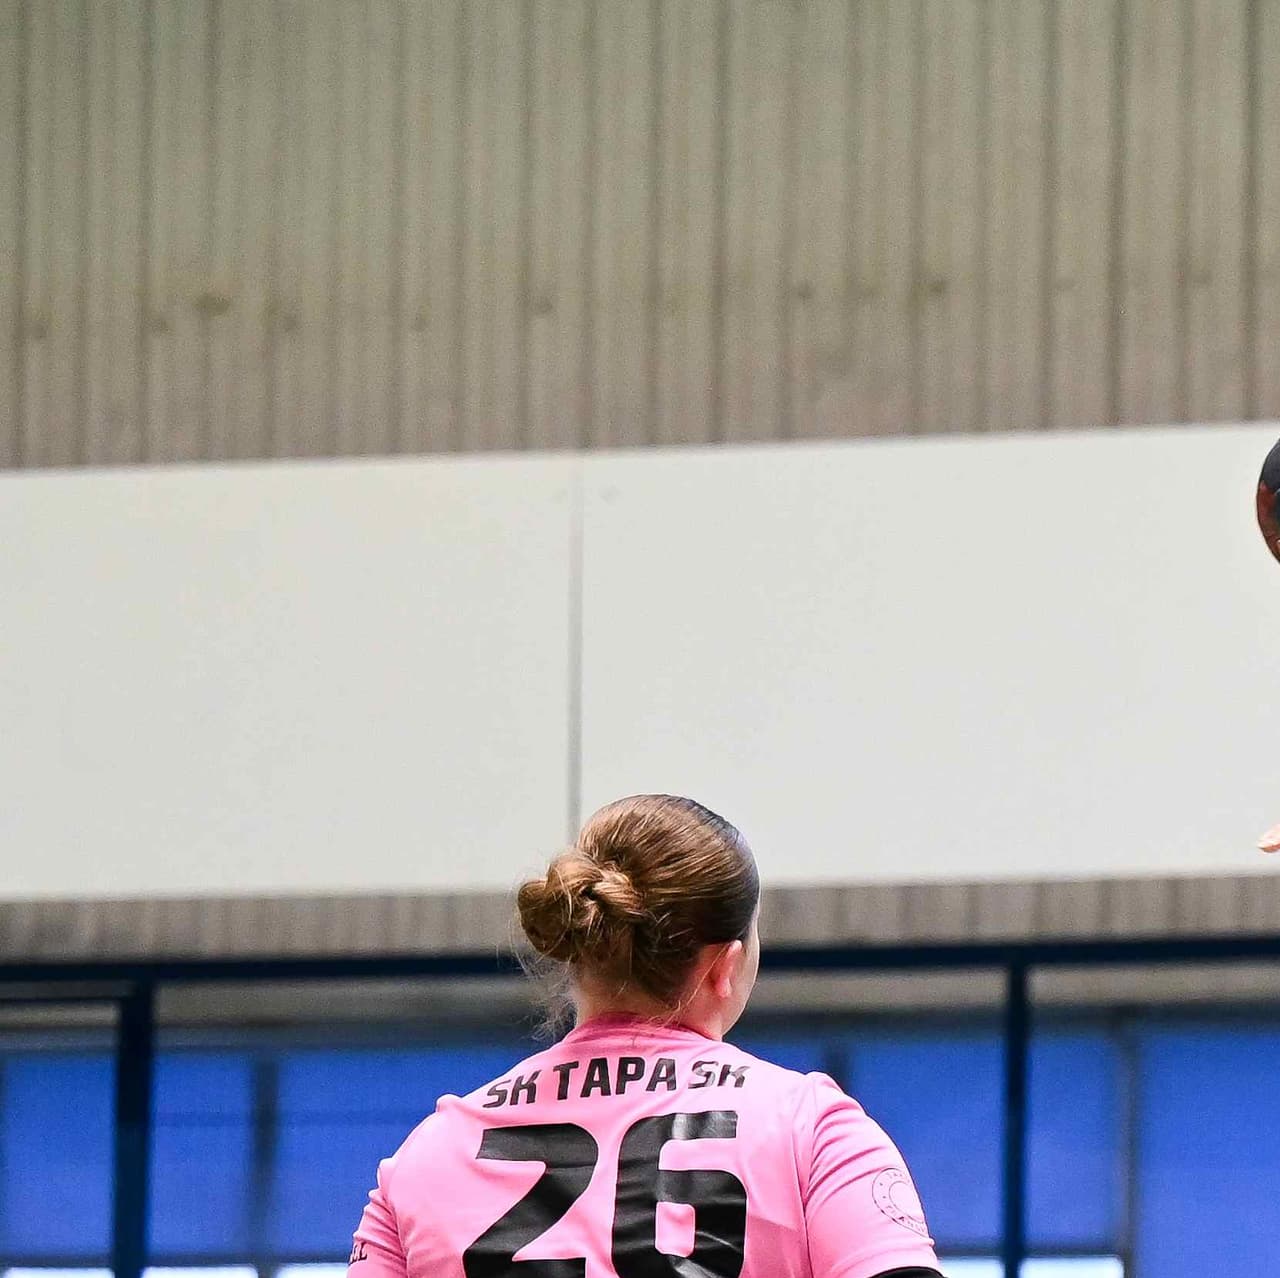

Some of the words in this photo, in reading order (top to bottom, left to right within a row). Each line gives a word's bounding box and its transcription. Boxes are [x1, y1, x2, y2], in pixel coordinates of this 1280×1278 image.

[482, 1069, 542, 1109] SK
[553, 1056, 678, 1101] TAPA
[687, 1060, 751, 1090] SK
